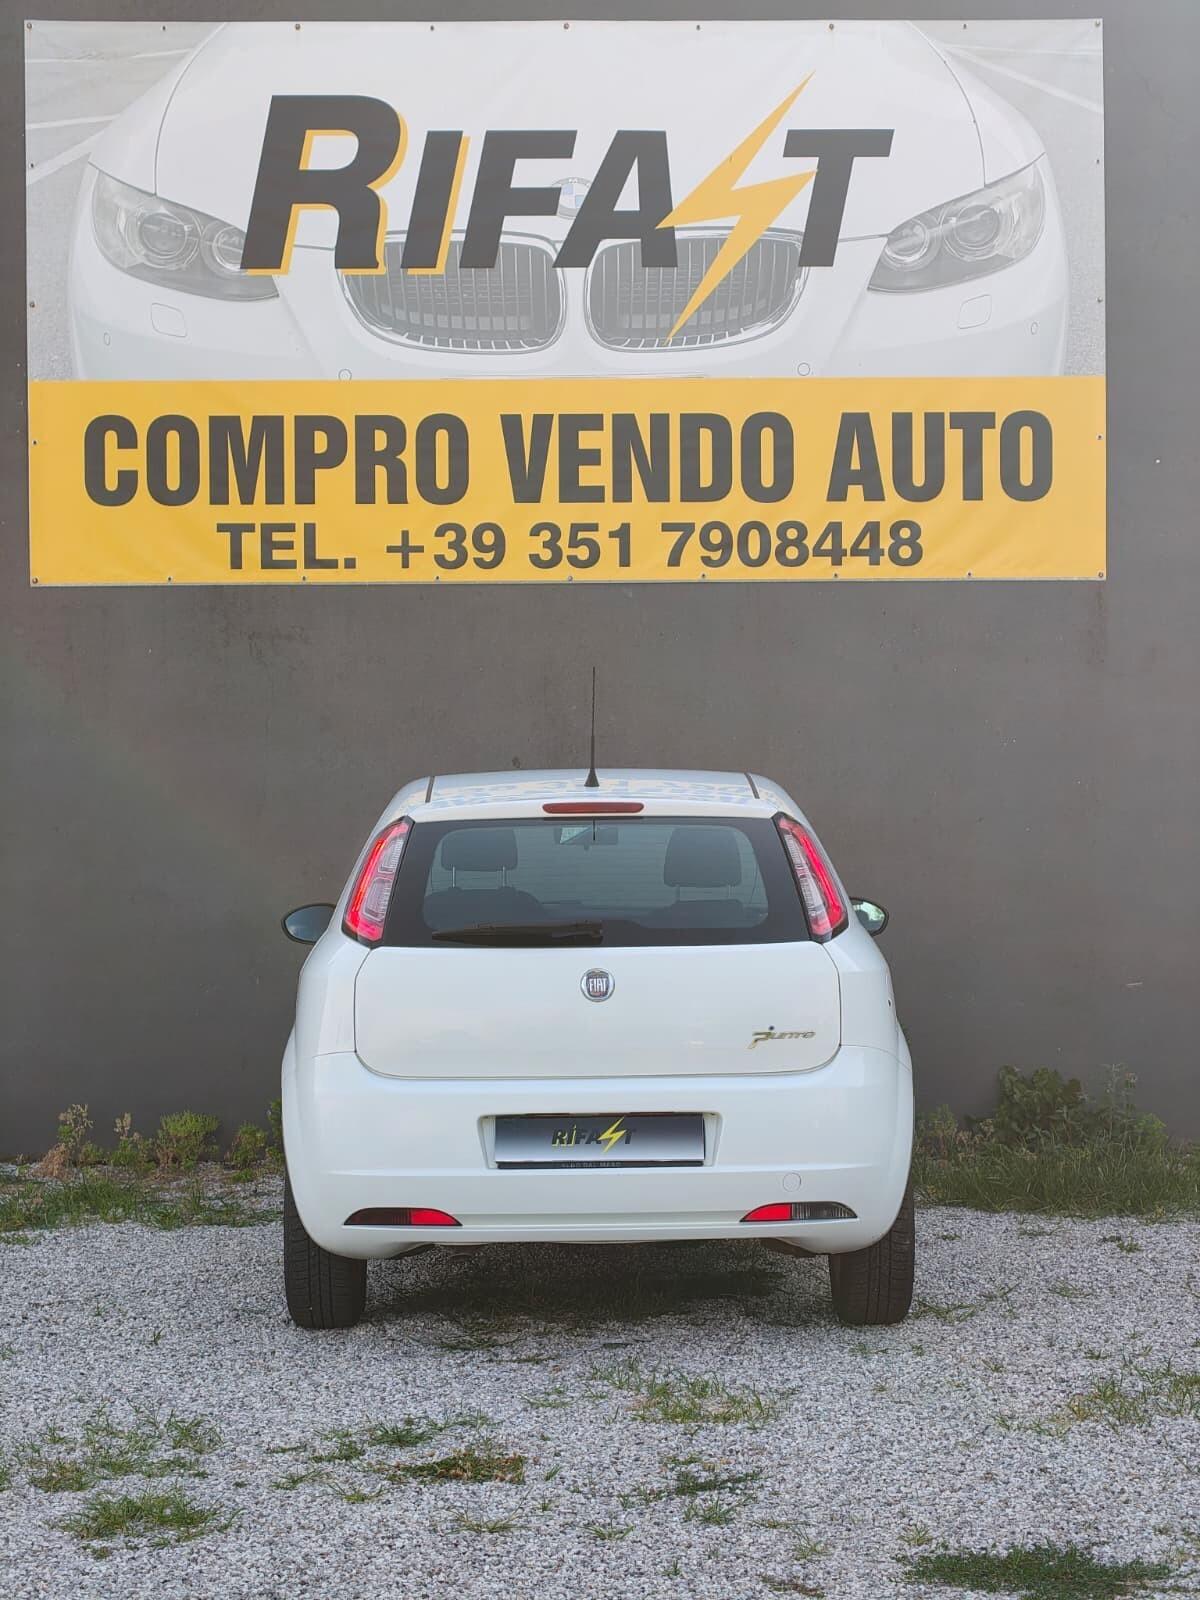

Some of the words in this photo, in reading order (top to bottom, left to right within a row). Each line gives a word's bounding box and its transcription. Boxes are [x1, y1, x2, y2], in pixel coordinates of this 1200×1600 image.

[85, 413, 470, 507] COMPRO
[500, 411, 795, 504] VENDO
[826, 410, 1053, 502] AUTO
[216, 522, 356, 570] TEL.
[386, 521, 506, 570] +39
[528, 521, 631, 569] 351
[661, 520, 923, 568] 7908448
[588, 977, 607, 993] FIAT
